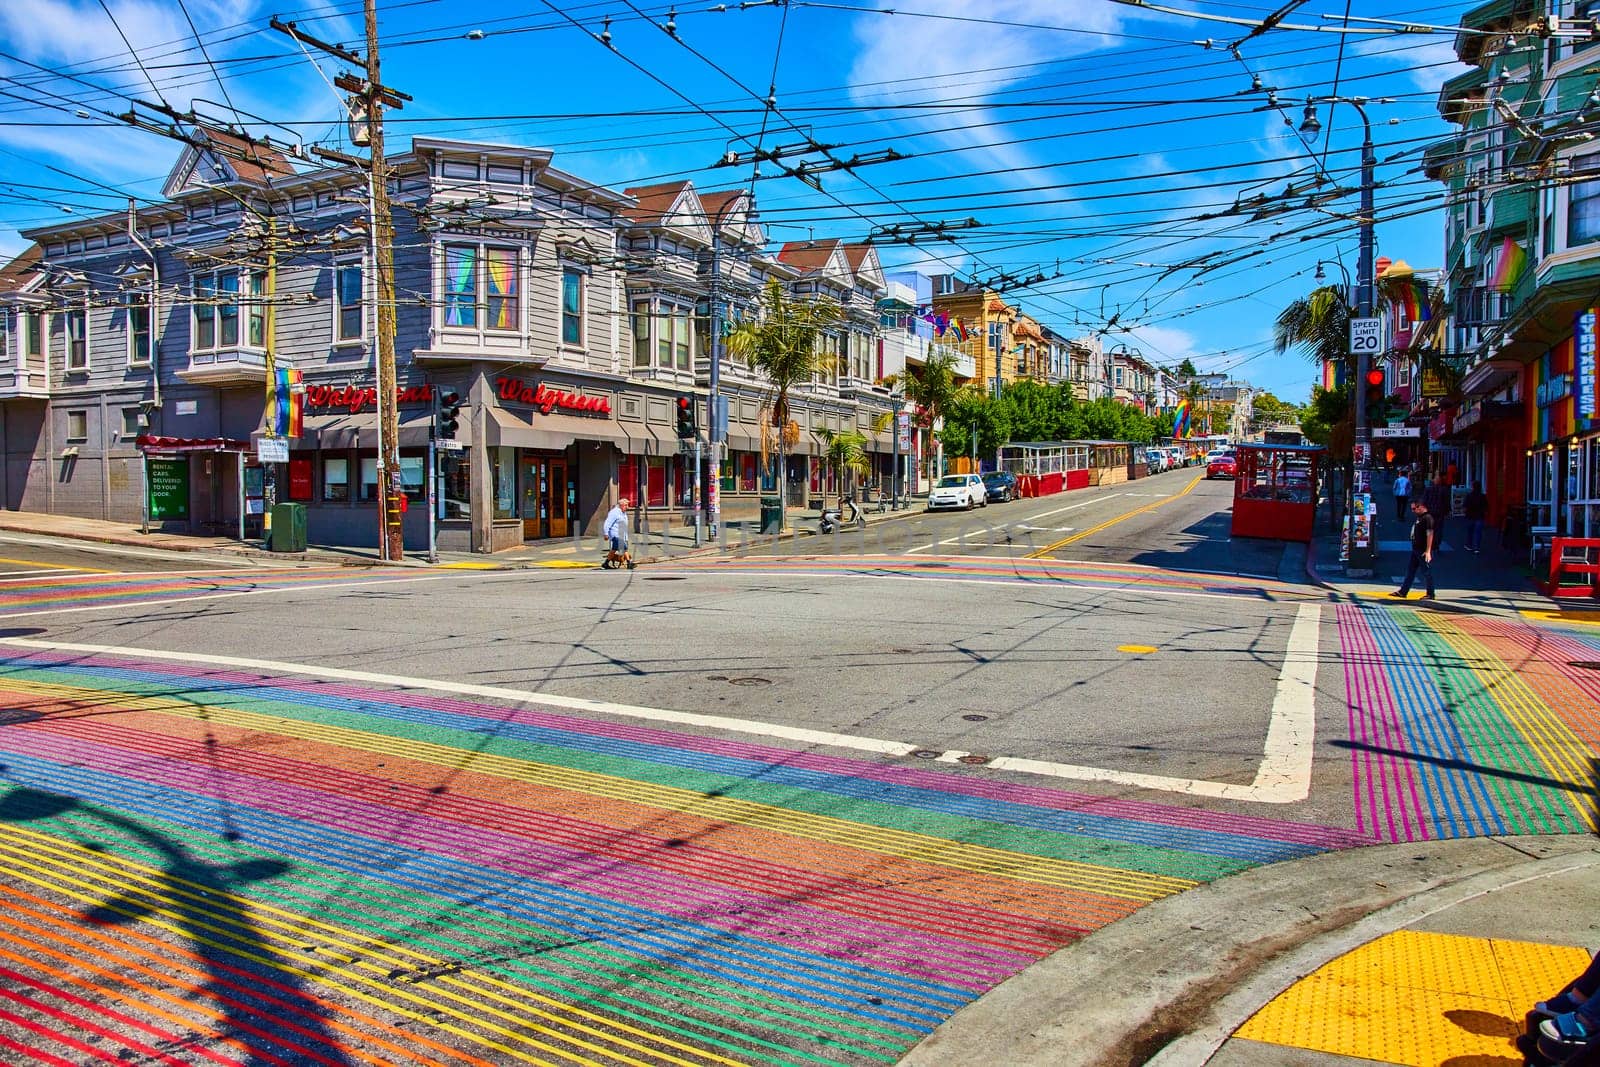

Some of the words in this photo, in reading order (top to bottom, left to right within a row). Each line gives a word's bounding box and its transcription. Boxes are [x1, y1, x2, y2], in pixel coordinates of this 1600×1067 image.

[1352, 321, 1379, 329] SPEED
[1355, 328, 1376, 336] LIMIT
[1353, 336, 1378, 350] 20
[306, 384, 432, 413] Walgrens
[496, 376, 611, 413] Walgreens
